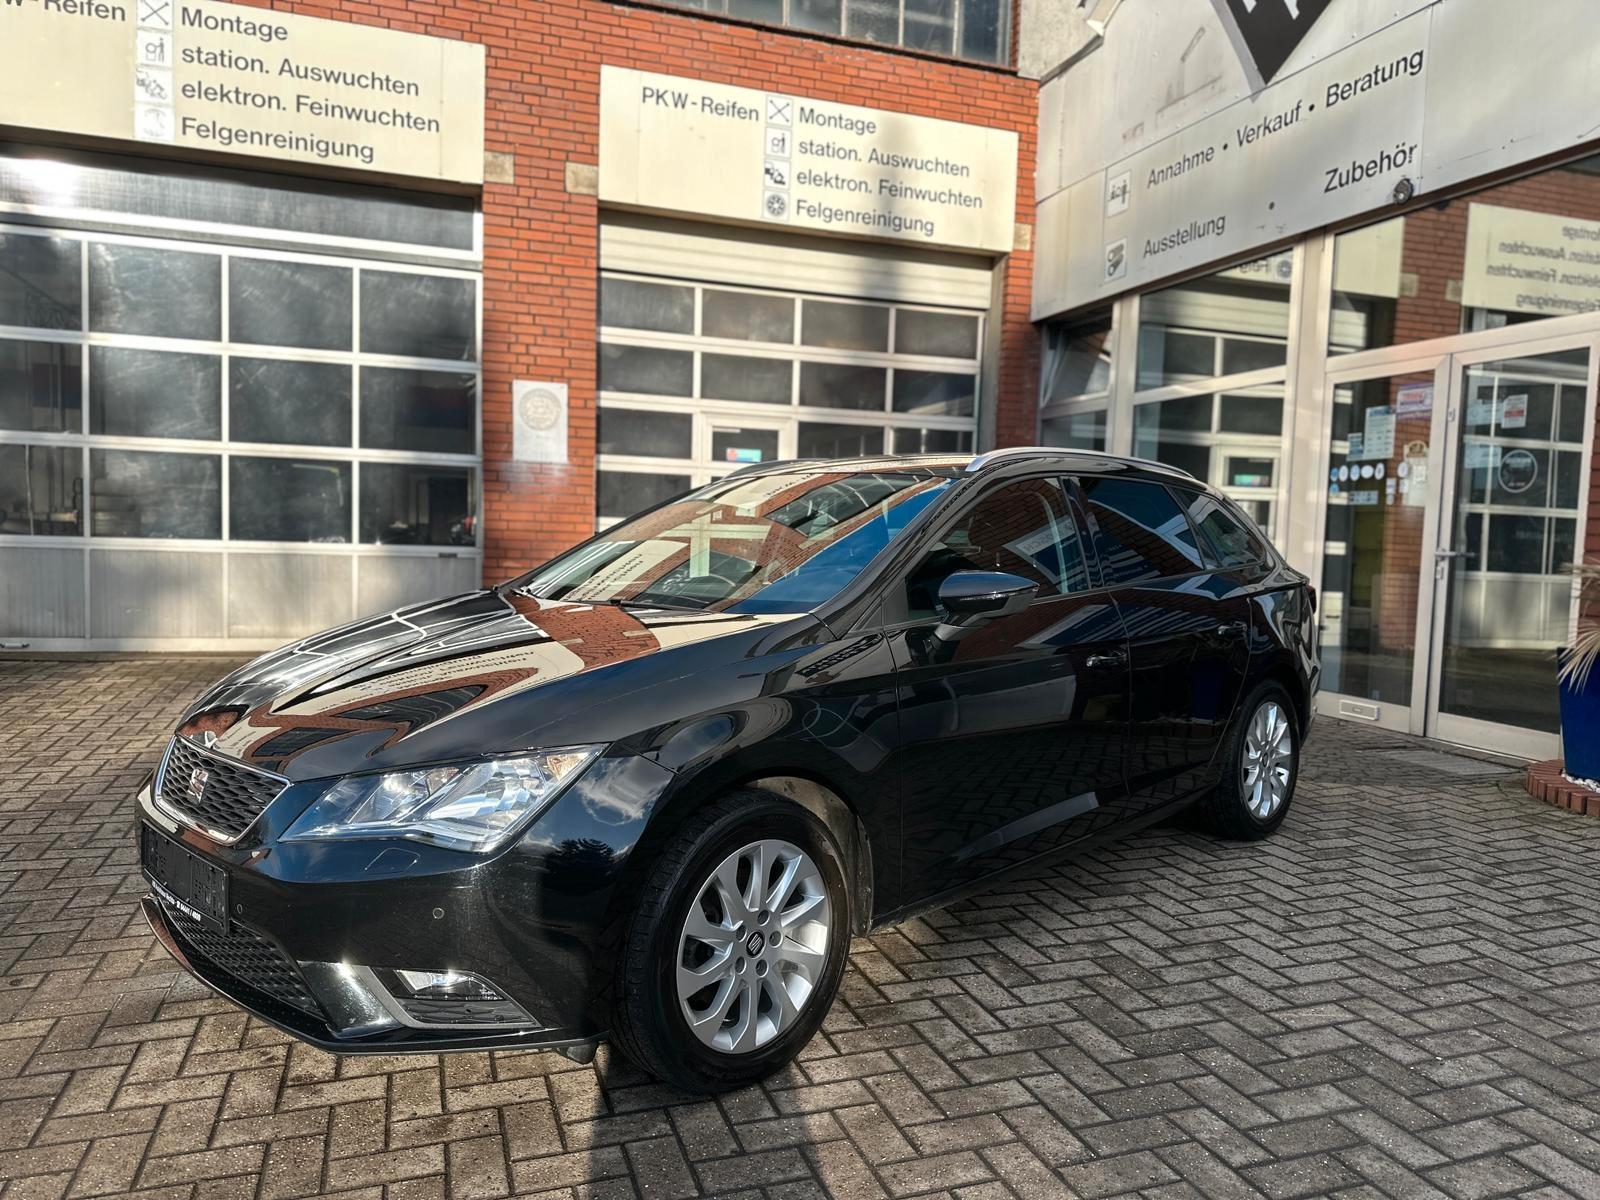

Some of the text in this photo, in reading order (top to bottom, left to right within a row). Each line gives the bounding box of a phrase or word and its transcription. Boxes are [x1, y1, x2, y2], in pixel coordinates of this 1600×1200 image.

[182, 7, 287, 42] Montage
[182, 47, 418, 96] station. Auswuchten
[182, 81, 439, 132] elektron. Feinwuchten
[643, 87, 759, 121] PKW-Reifen
[800, 107, 876, 135] Montage
[1147, 50, 1423, 188] Annahme Verkauf Beratung
[182, 117, 373, 164] Felgenreinigung
[799, 140, 969, 177] station. Auswuchten
[1324, 143, 1417, 193] Zubehör
[797, 169, 982, 208] elektron. Feinwuchten
[797, 199, 934, 236] Felgenreinigung
[1143, 216, 1225, 258] Ausstellung
